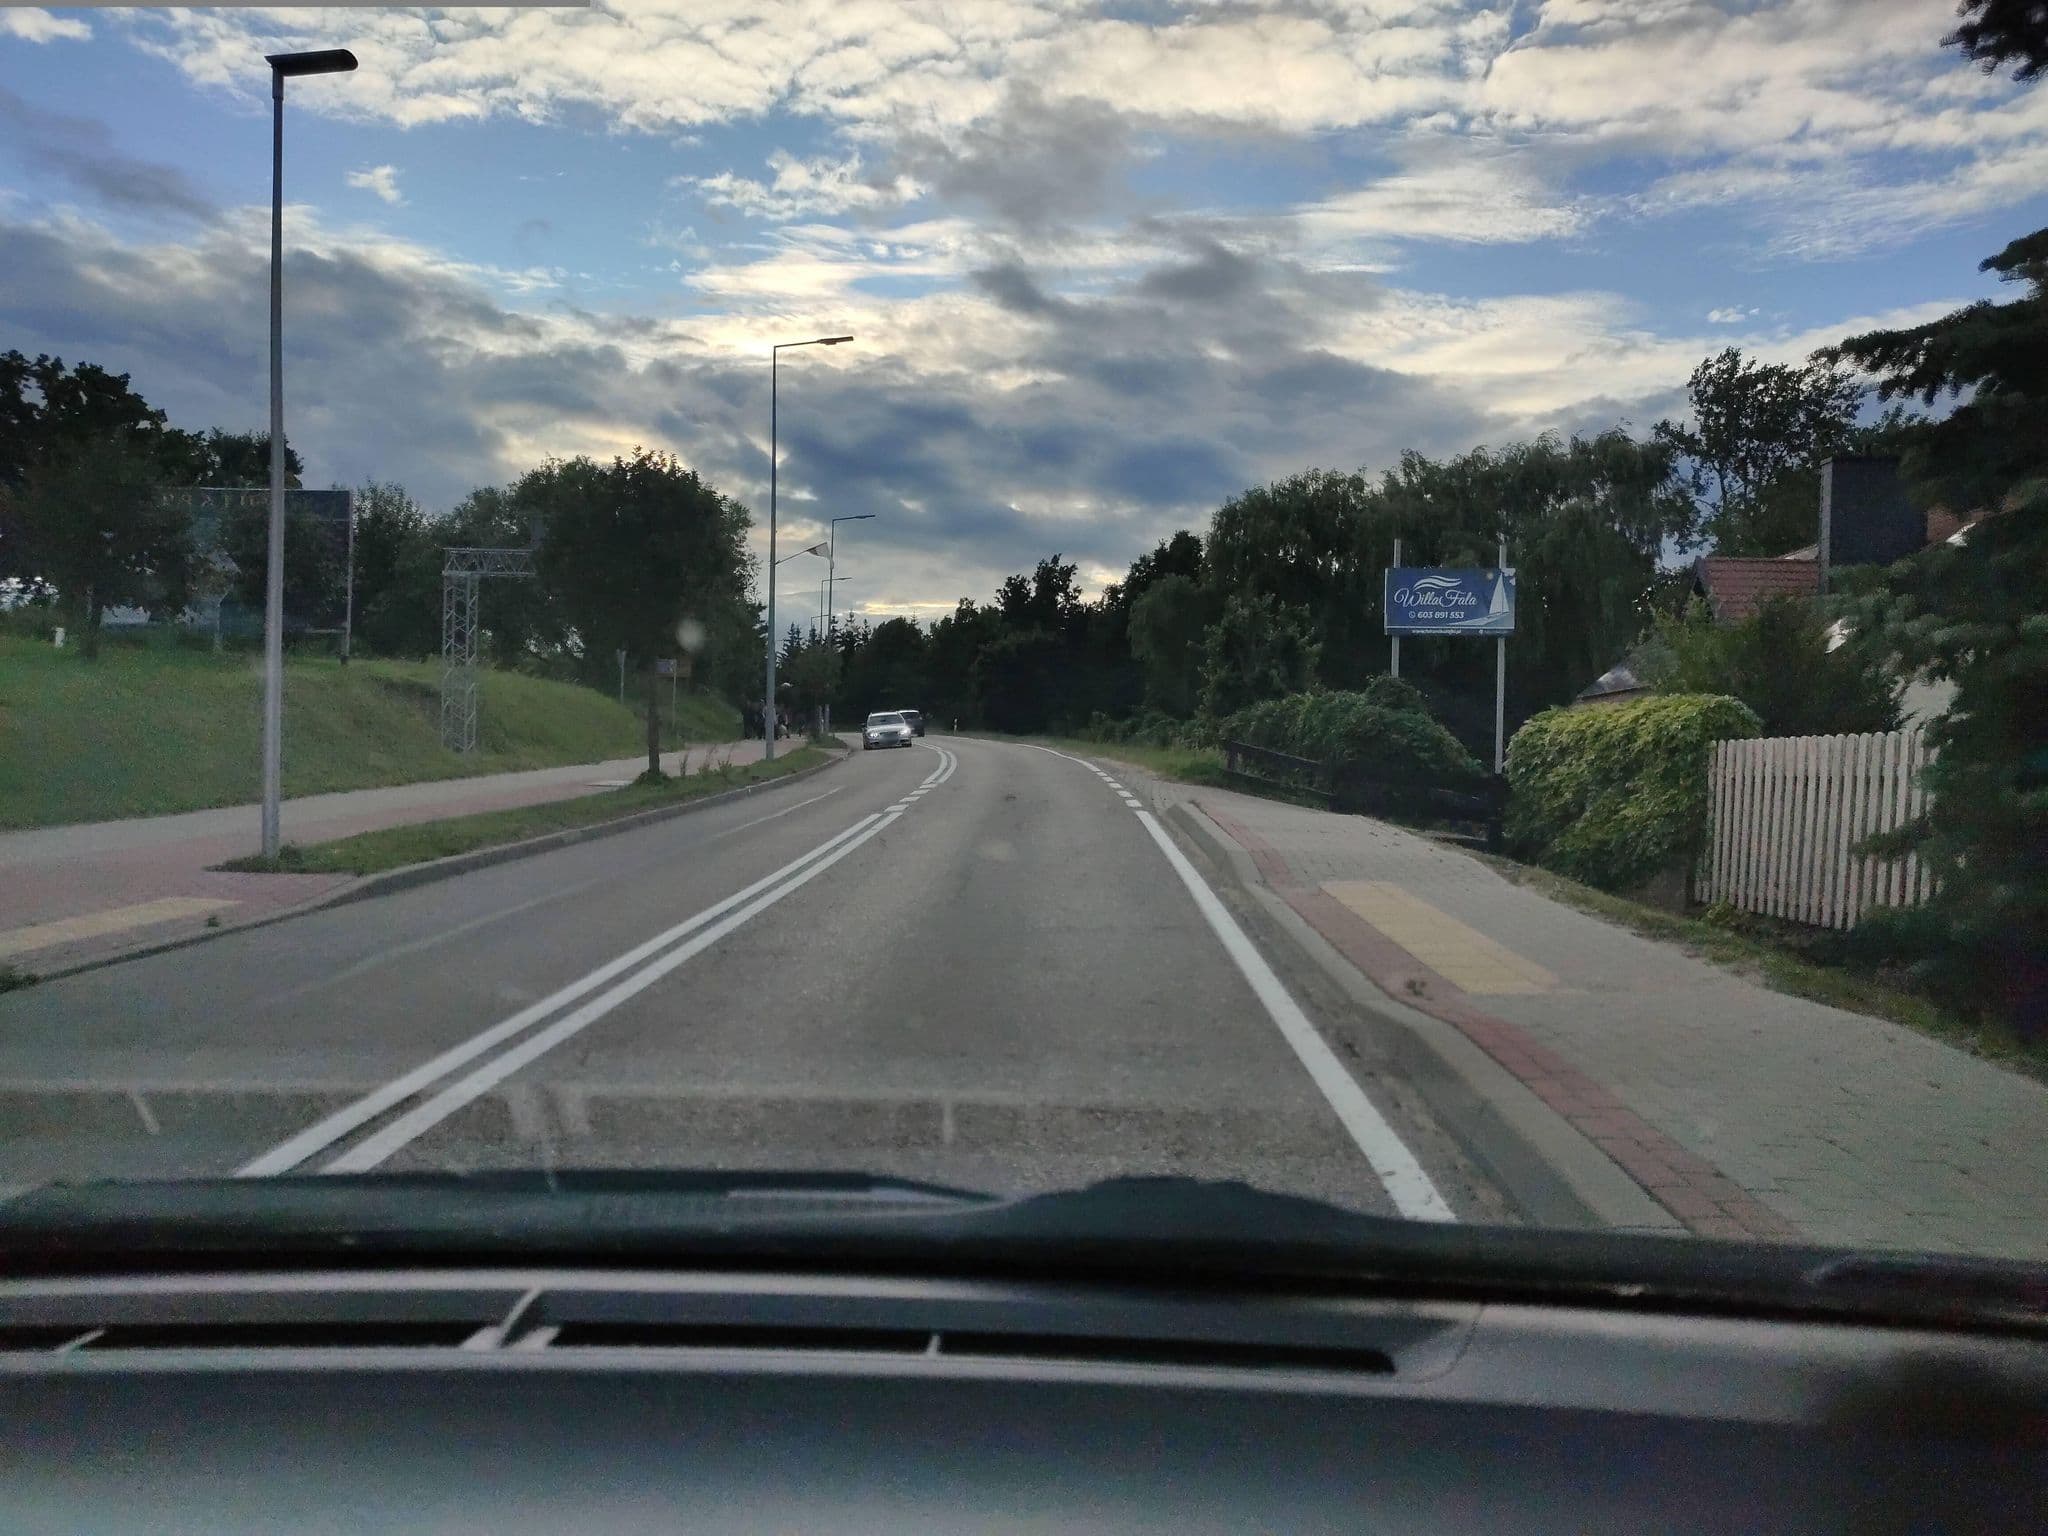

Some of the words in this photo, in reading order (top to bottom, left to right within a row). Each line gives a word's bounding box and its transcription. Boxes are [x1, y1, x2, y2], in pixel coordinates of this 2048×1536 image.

[1394, 588, 1440, 607] Willa
[1439, 589, 1477, 608] Fala
[1417, 611, 1433, 619] 603
